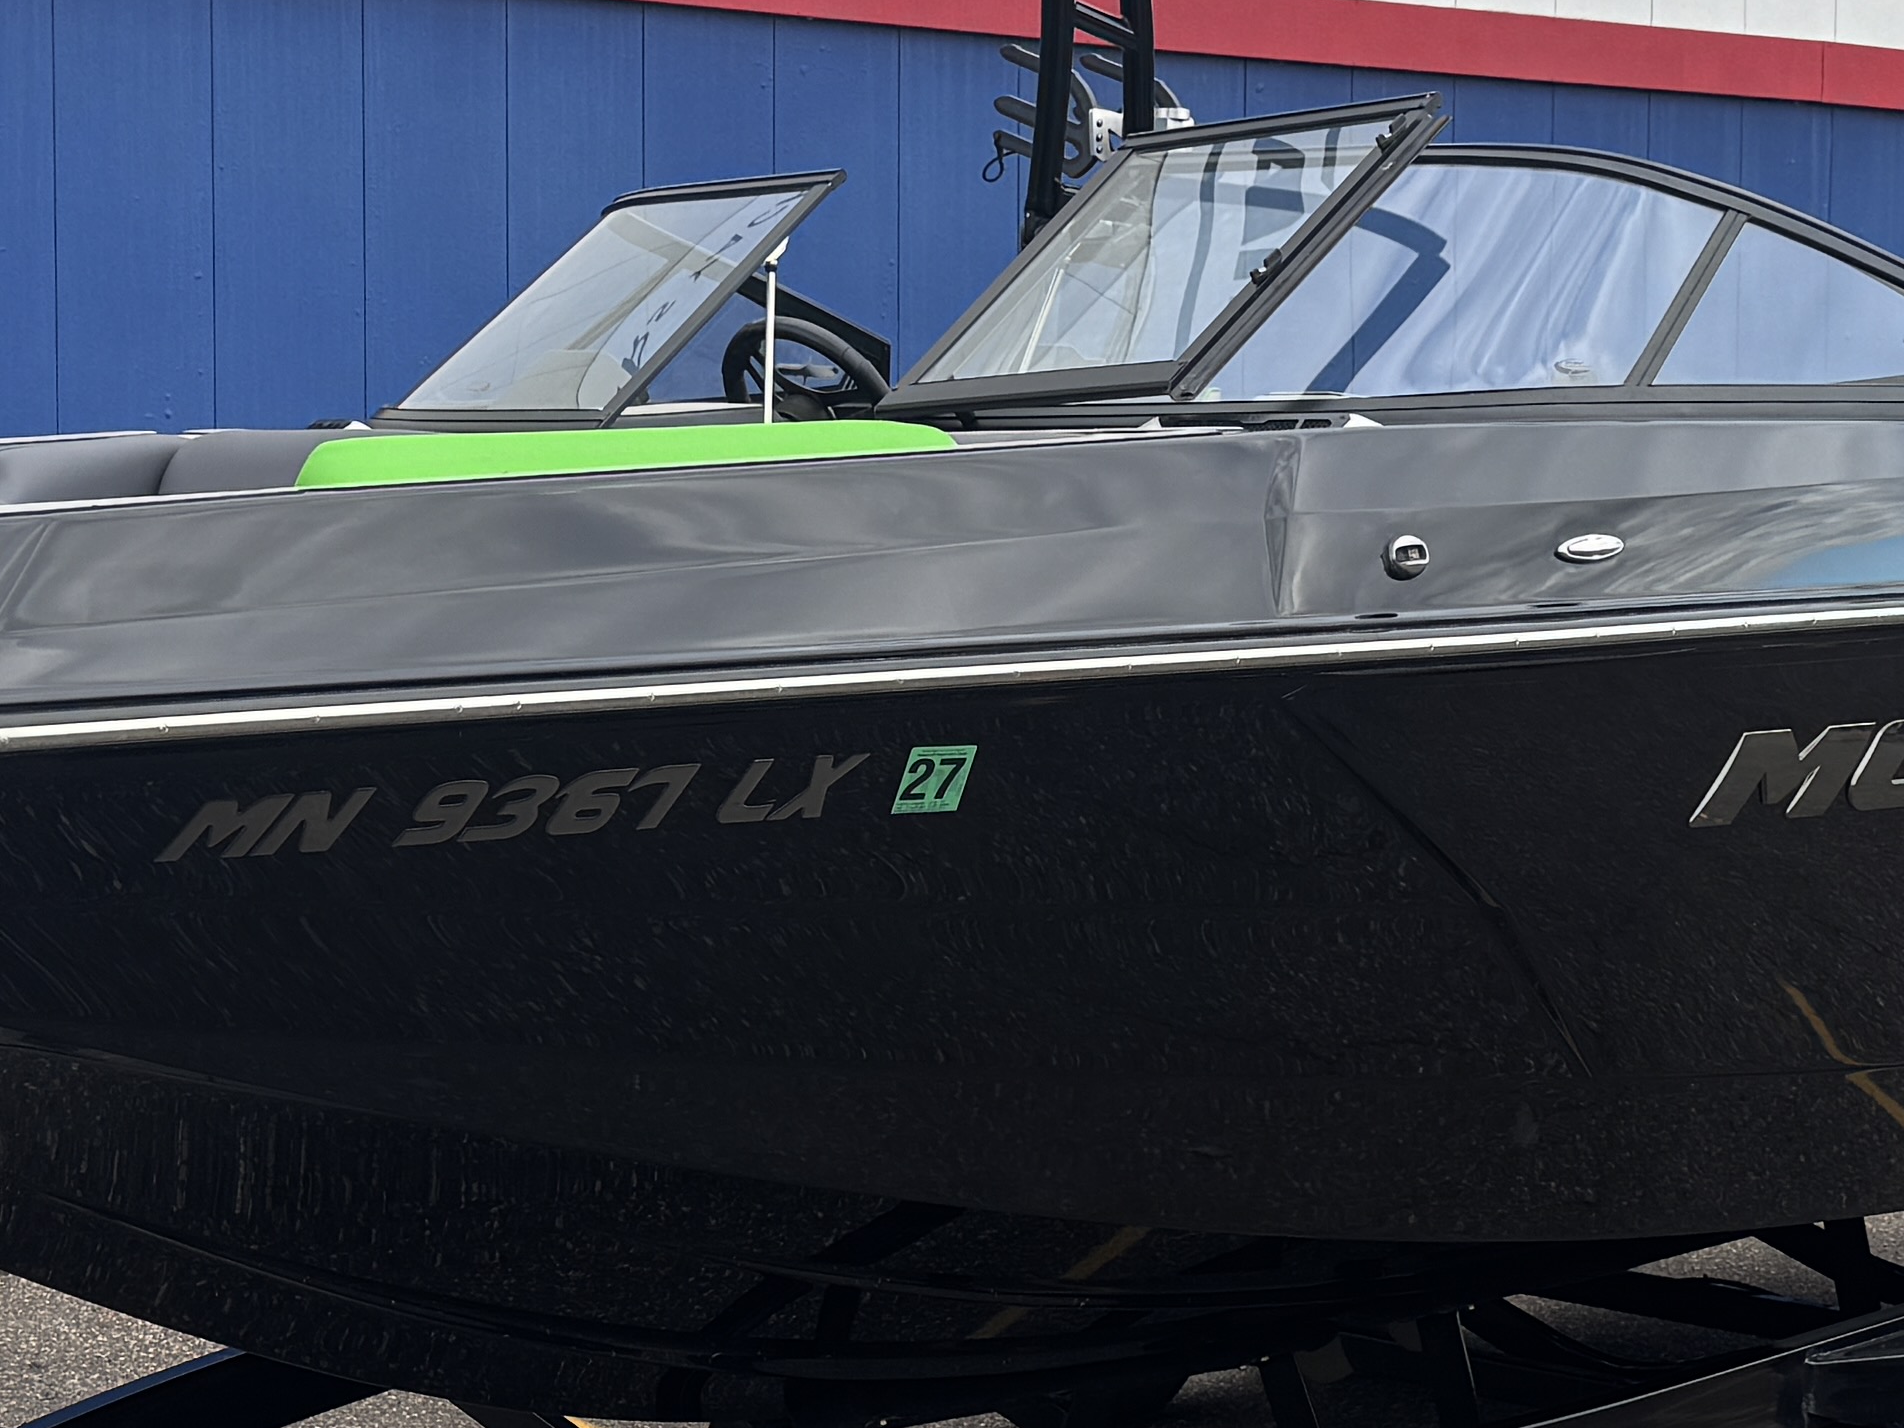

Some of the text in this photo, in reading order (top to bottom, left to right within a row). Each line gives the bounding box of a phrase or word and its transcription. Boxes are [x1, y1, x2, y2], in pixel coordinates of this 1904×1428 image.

[154, 752, 871, 863] MN 9367 LX
[898, 757, 968, 801] 27
